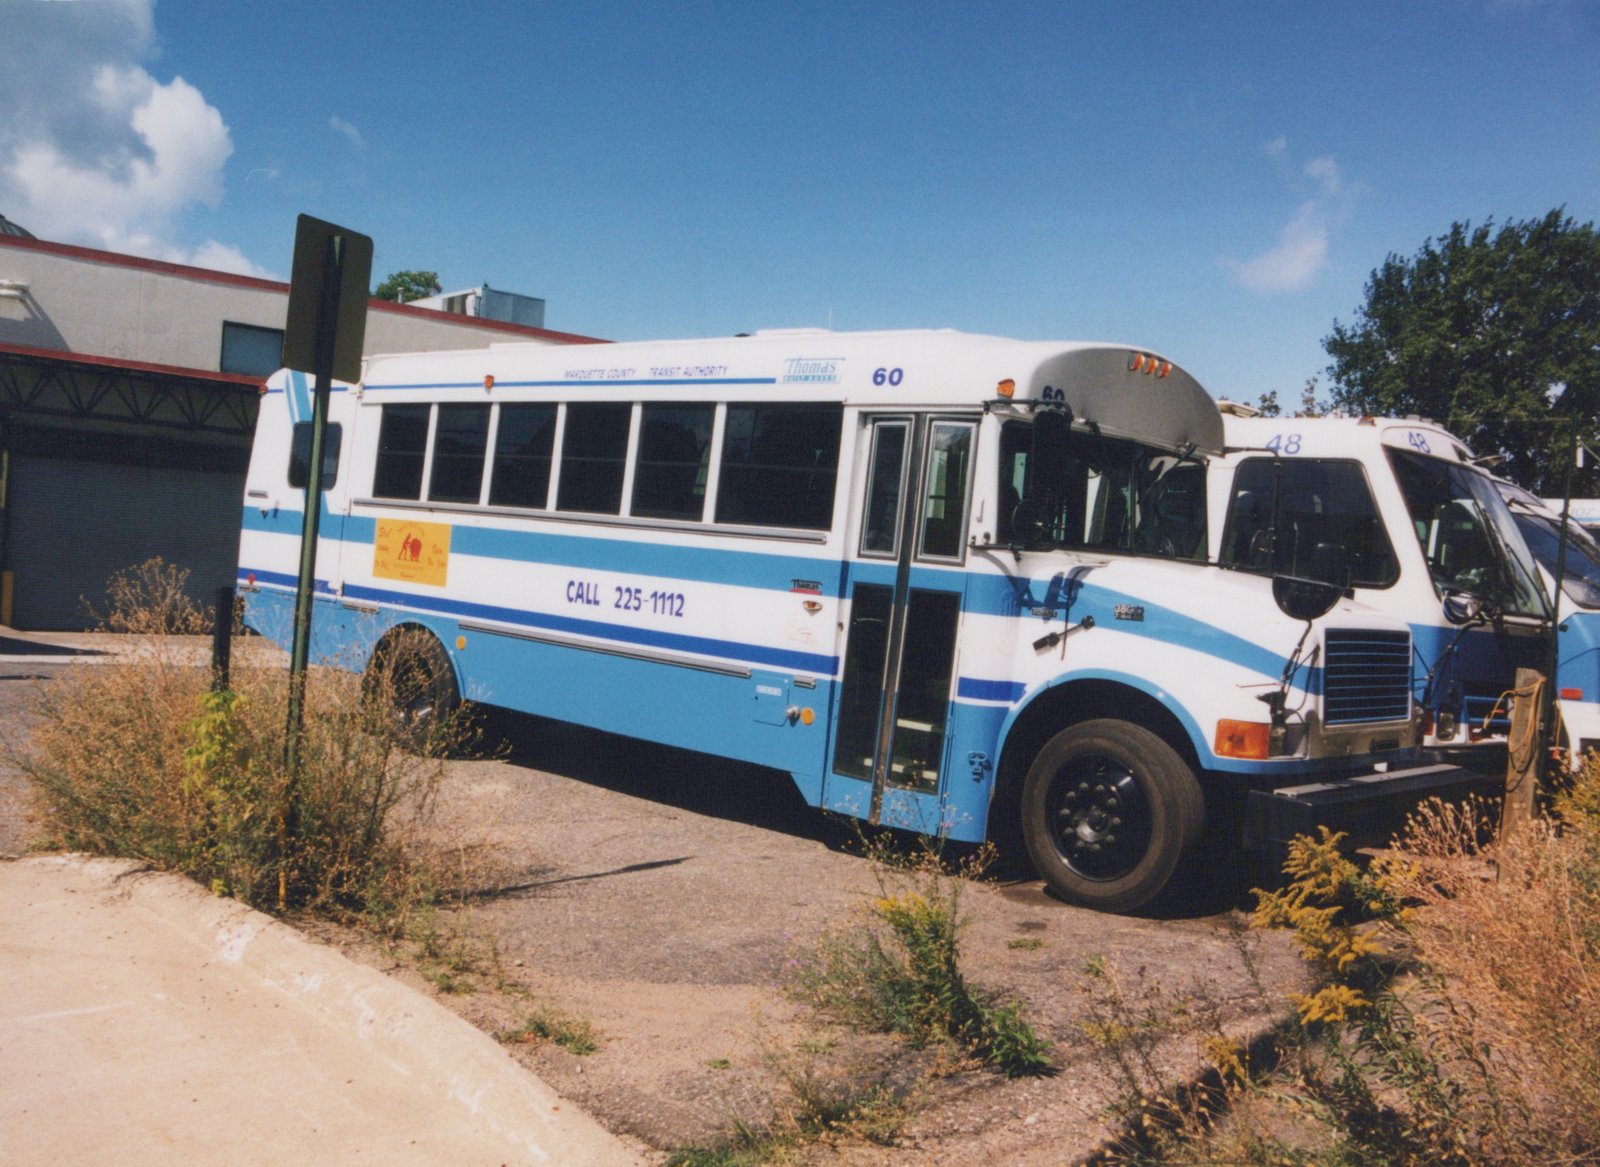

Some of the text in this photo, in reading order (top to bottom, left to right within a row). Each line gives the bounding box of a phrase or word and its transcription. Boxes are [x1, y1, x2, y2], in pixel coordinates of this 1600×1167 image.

[564, 365, 728, 379] MARQUETTE COUNTY TRANSIT AUTHORITY
[784, 356, 845, 374] Thomas
[872, 367, 904, 386] 60
[1265, 434, 1302, 455] 48
[1408, 431, 1431, 454] 48
[566, 580, 685, 617] CALL 225-1112
